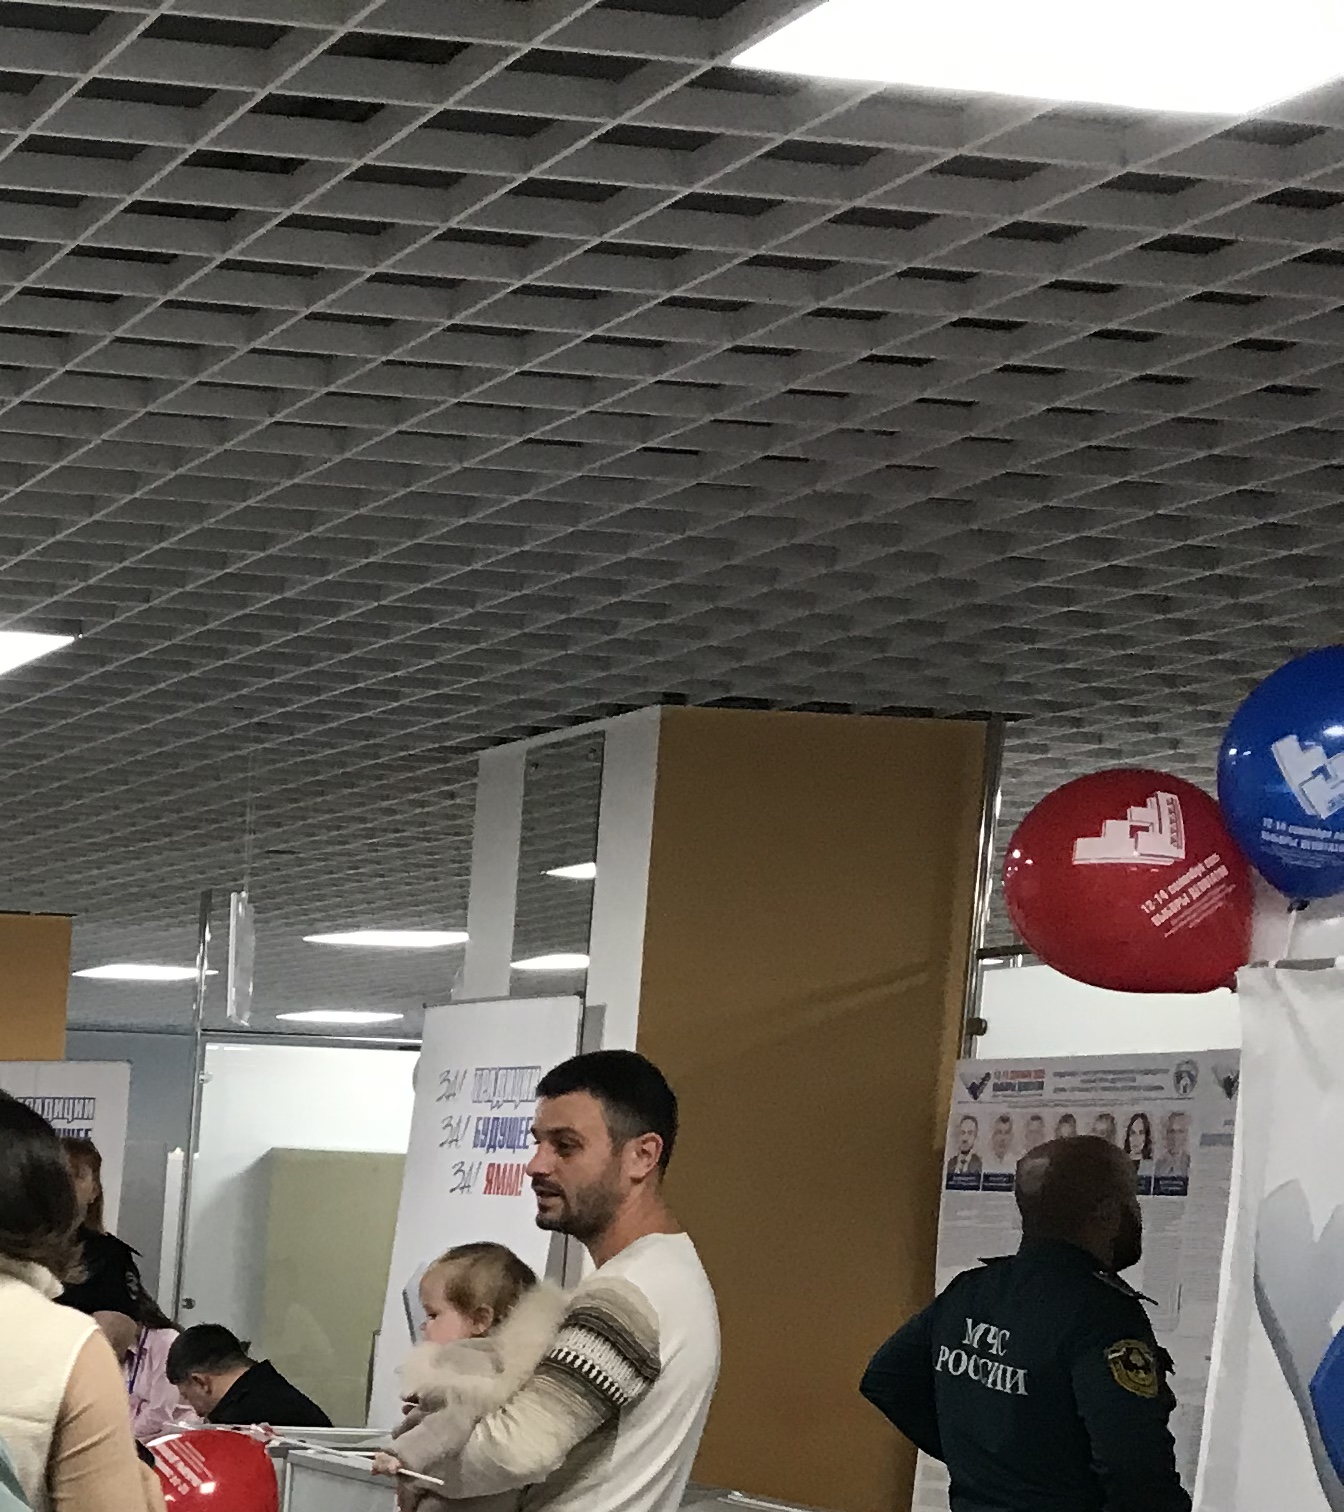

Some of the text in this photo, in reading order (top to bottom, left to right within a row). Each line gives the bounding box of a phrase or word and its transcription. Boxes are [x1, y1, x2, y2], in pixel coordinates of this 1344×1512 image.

[472, 1116, 534, 1154] БУДУЩЕЕ
[450, 1161, 482, 1195] ЗА!
[962, 1317, 1010, 1356] МЧС
[935, 1345, 1029, 1396] РОССИИ
